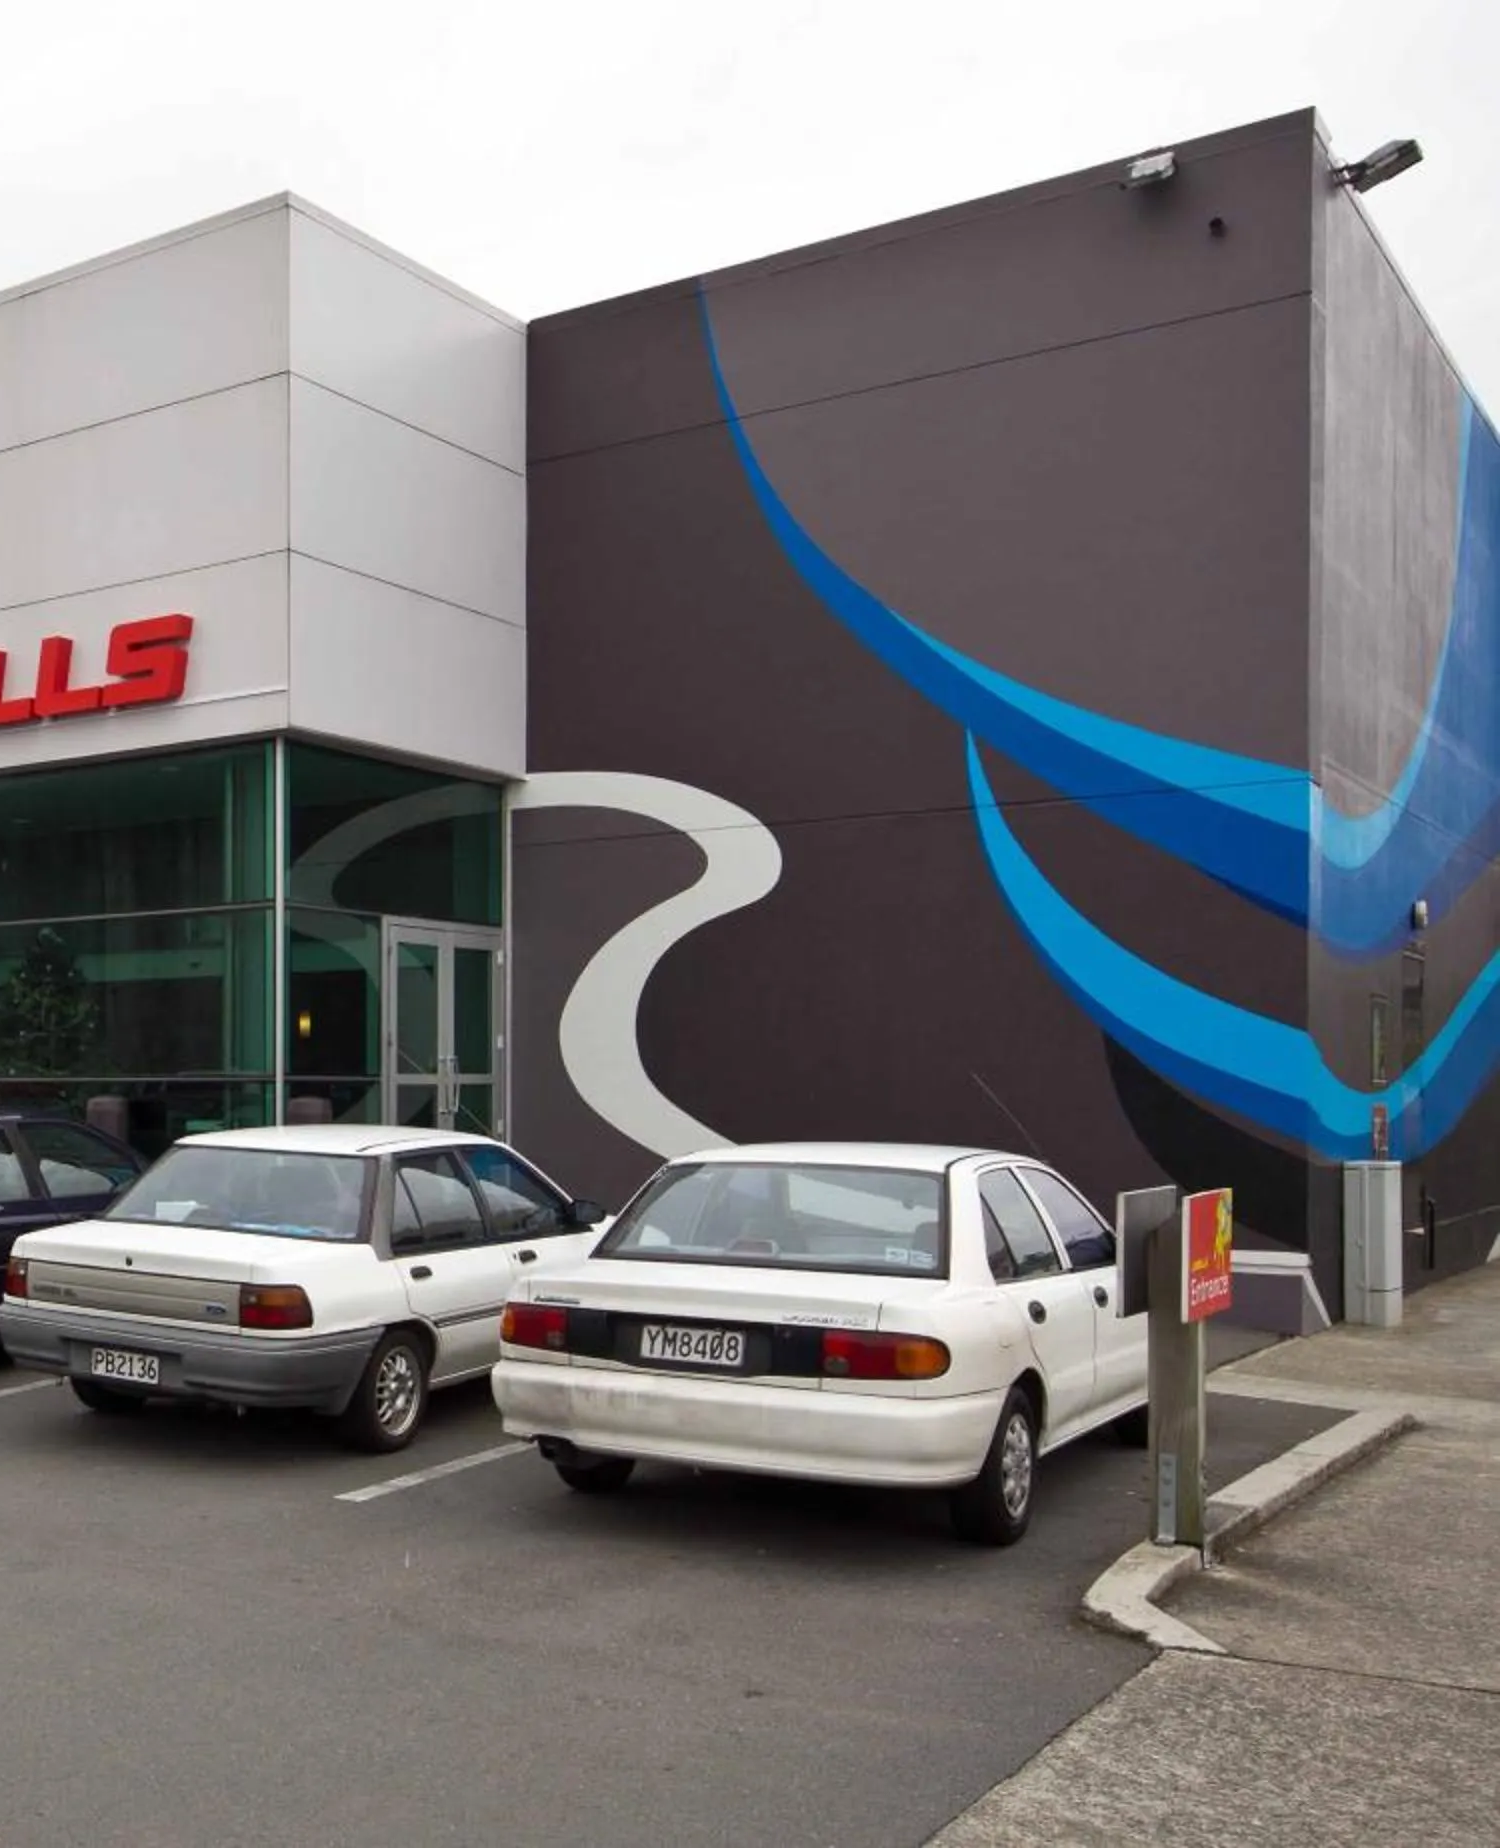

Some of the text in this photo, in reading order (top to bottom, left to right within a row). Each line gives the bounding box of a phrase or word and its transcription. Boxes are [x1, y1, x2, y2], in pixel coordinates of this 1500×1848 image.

[1191, 1275, 1229, 1307] Entrance
[646, 1327, 741, 1362] YM8408
[93, 1351, 158, 1380] PB2136
